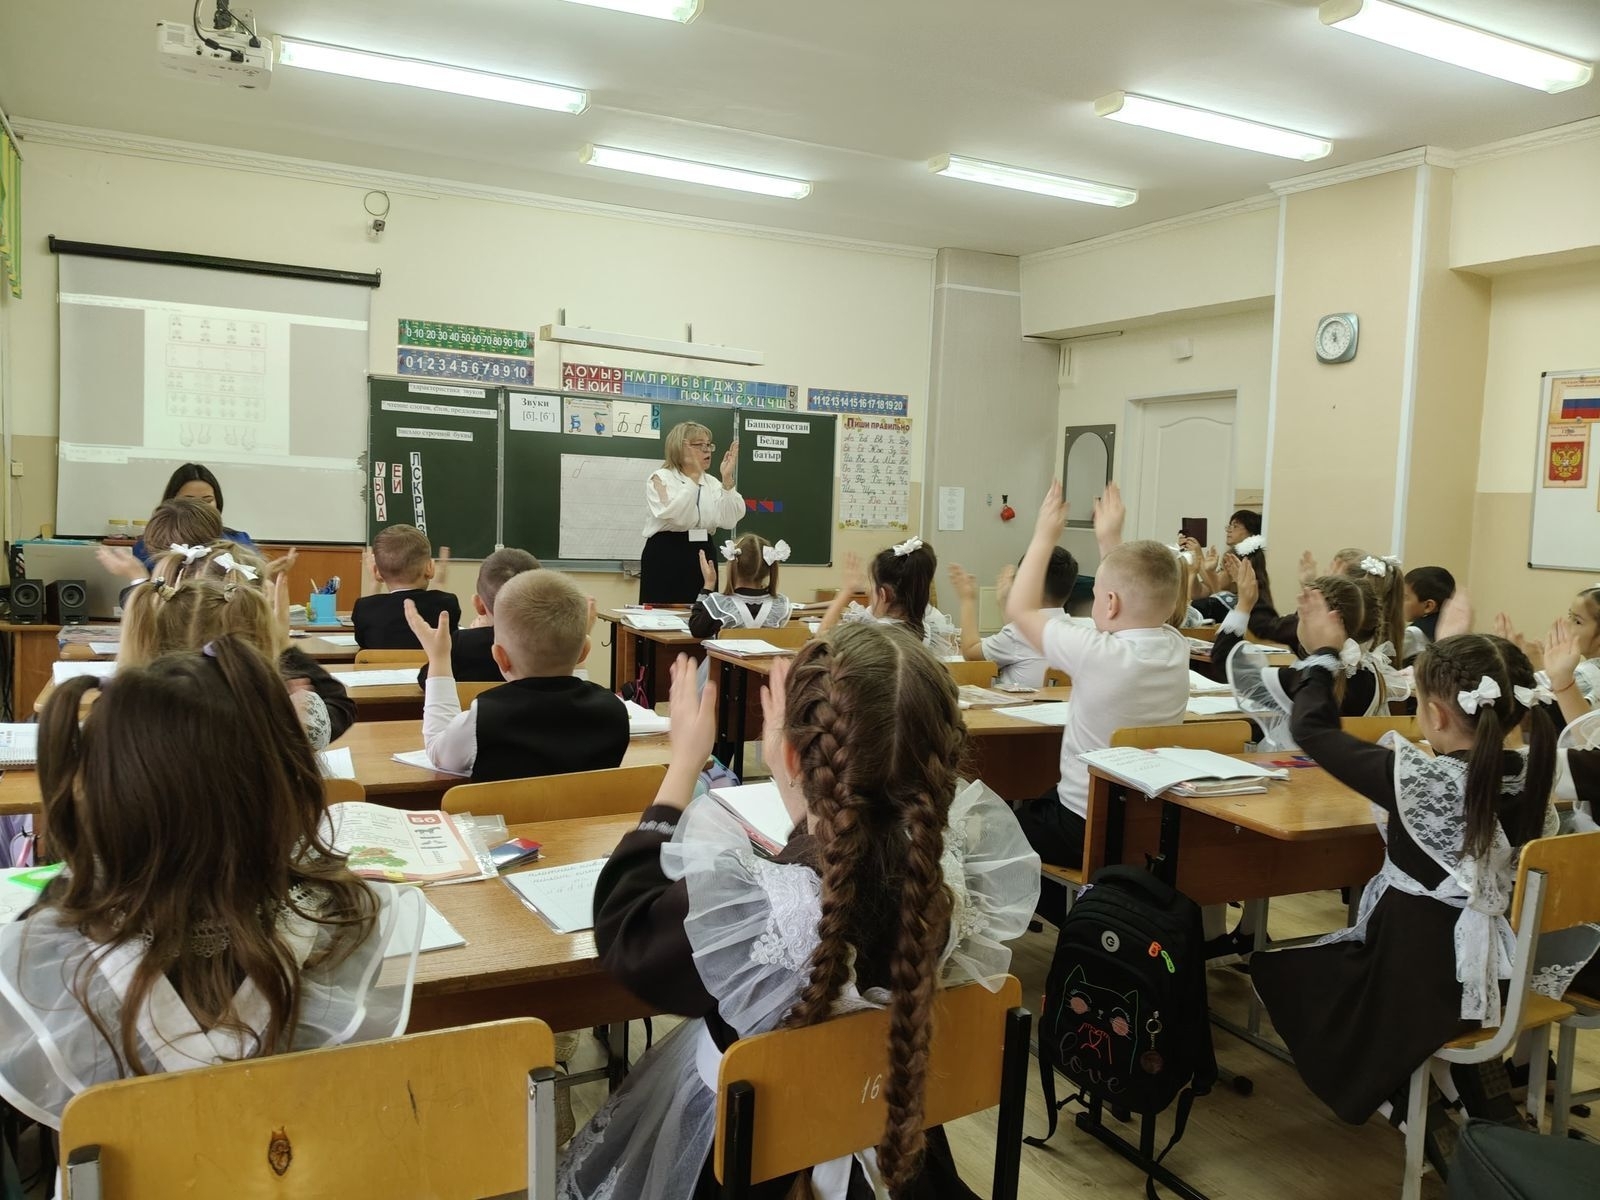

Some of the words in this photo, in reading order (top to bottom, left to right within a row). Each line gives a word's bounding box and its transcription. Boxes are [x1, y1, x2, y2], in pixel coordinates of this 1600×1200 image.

[407, 328, 411, 336] 0
[414, 329, 424, 338] 10
[426, 330, 436, 339] 20
[439, 331, 448, 340] 30
[450, 333, 459, 341] 40
[461, 334, 470, 342] 50
[472, 335, 481, 343] 60
[482, 336, 491, 345] 70
[493, 337, 502, 345] 80
[503, 338, 512, 347] 90
[514, 340, 527, 348] 100
[406, 356, 413, 368] 0
[416, 357, 422, 368] 1
[428, 358, 434, 369] 2
[439, 359, 446, 370] 3
[450, 360, 457, 372] 4
[461, 362, 468, 373] 5
[472, 362, 479, 374] 6
[482, 364, 489, 375] 7
[493, 365, 499, 376] 8
[504, 366, 510, 377] 9
[514, 367, 527, 378] 10
[522, 398, 549, 408] Звуки
[813, 396, 821, 405] 11
[822, 396, 830, 406] 12
[831, 397, 840, 406] 13
[840, 398, 849, 407] 14
[850, 398, 858, 408] 15
[859, 398, 867, 408] 16
[868, 399, 876, 409] 17
[877, 400, 885, 409] 18
[885, 400, 893, 410] 19
[894, 401, 903, 410] 20
[747, 420, 809, 432] Башкортостан
[760, 436, 784, 446] Белая
[754, 450, 781, 462] батыр
[861, 1073, 882, 1104] 16
